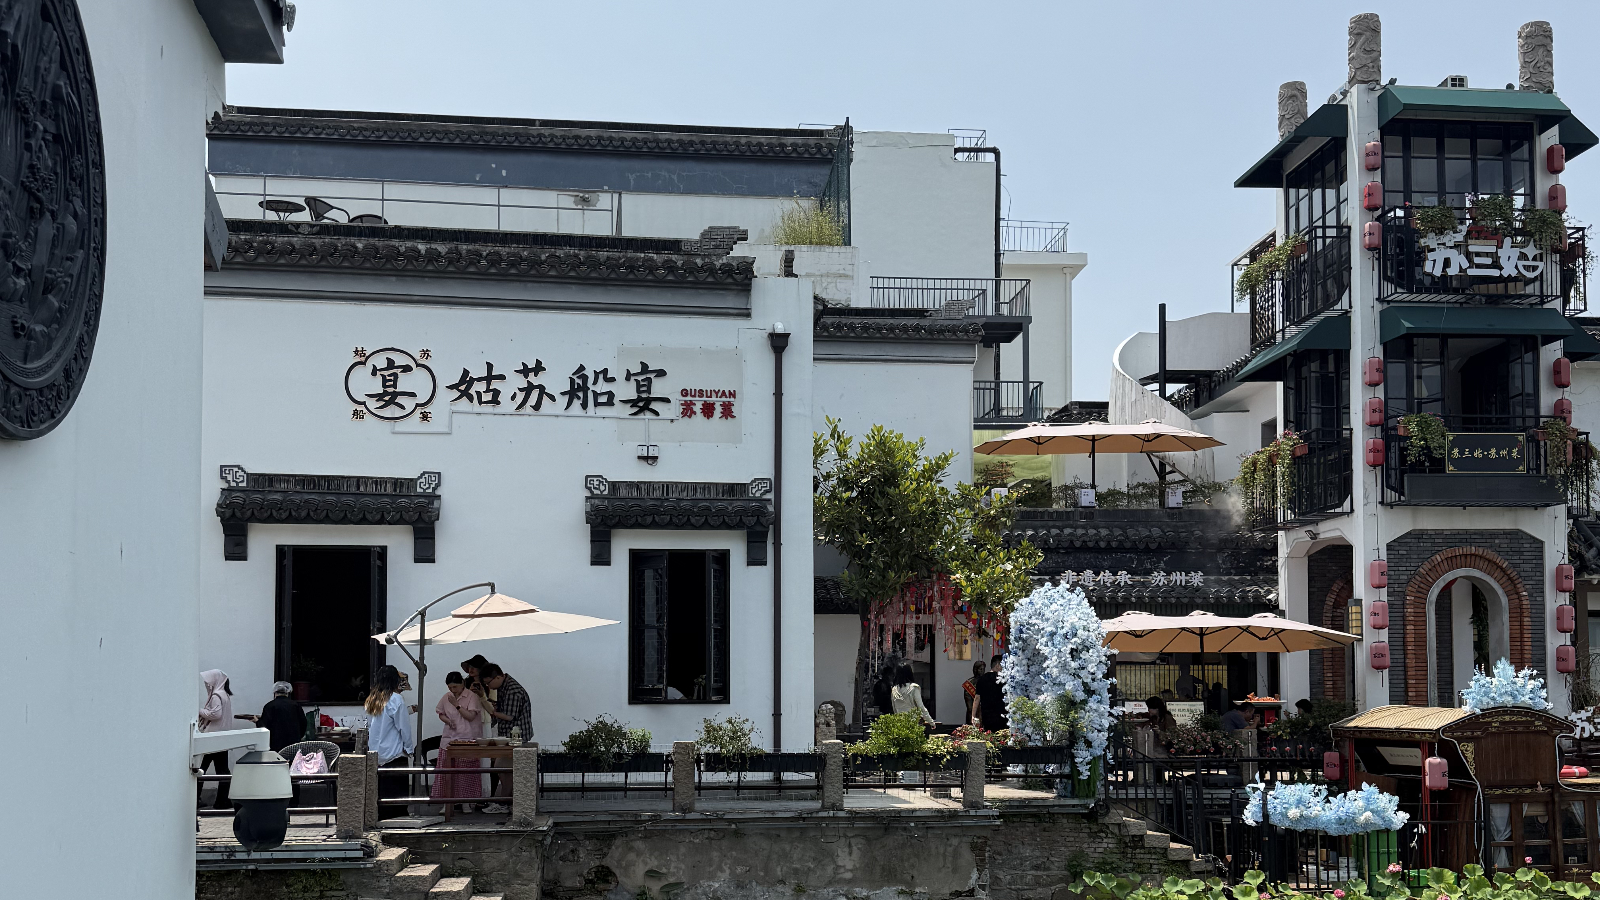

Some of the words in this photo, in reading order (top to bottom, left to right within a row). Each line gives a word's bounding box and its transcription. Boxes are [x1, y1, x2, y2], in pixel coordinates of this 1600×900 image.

[353, 347, 367, 358] 姑
[419, 348, 432, 360] 苏
[364, 356, 418, 411] 宴
[445, 358, 671, 416] 姑苏船宴
[680, 388, 736, 399] GUSUYAN
[351, 408, 366, 420] 船
[680, 400, 736, 420] 苏帮菜
